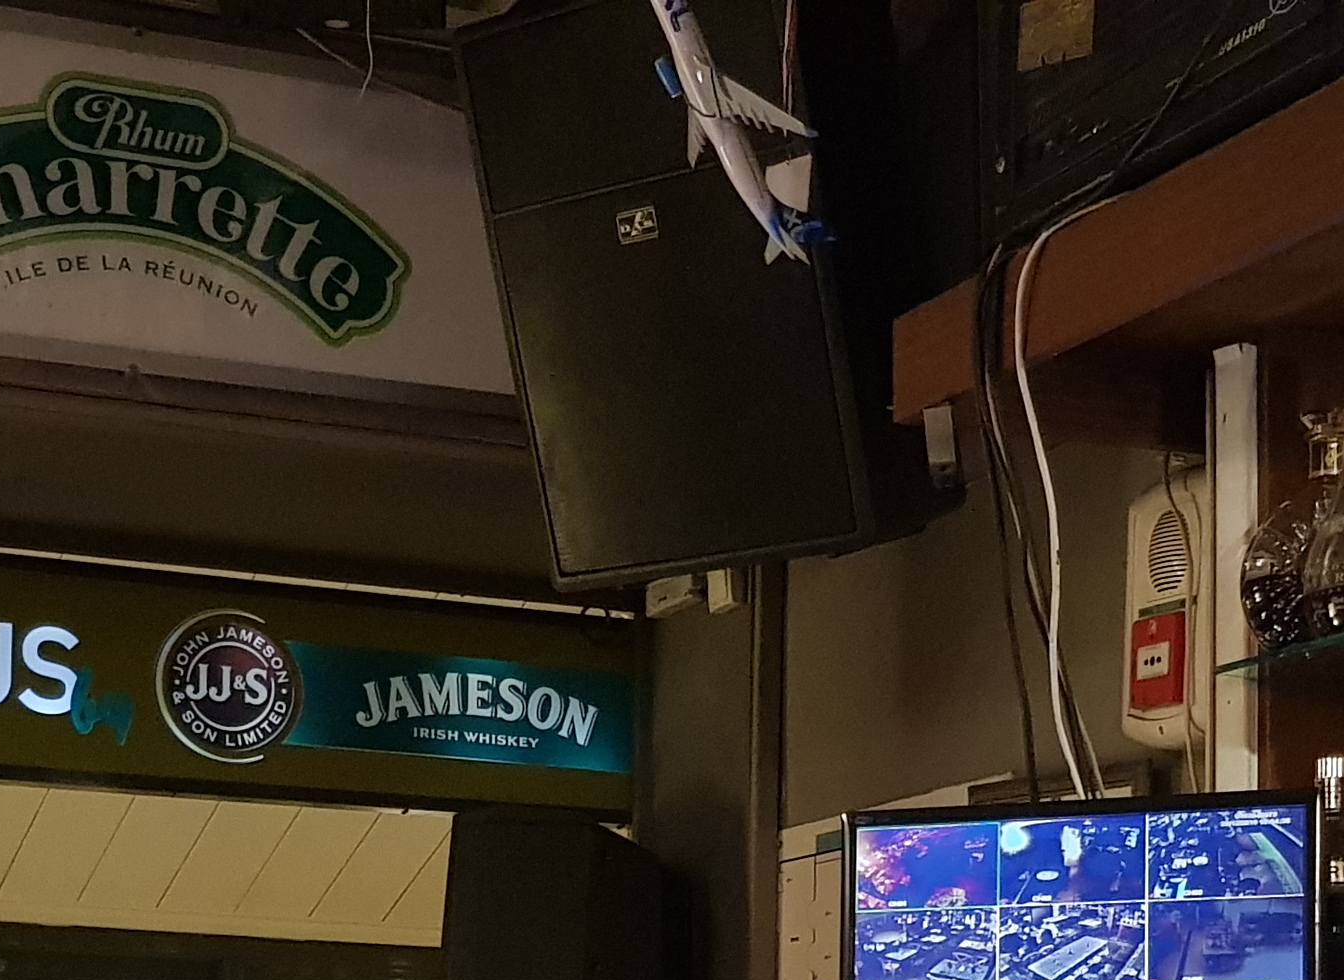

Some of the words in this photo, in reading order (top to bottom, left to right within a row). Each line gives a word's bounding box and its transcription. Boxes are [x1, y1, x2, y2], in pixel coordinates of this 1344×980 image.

[73, 93, 207, 156] Rhum
[4, 261, 47, 286] ILE
[57, 254, 91, 274] DE
[102, 253, 132, 273] LA
[144, 260, 260, 318] RÉUNION
[172, 630, 210, 677] JOHN
[215, 625, 290, 684] JAMESON
[185, 663, 270, 706] JJ&S
[355, 671, 601, 748] JAMESON
[181, 710, 218, 743] SON
[225, 700, 288, 747] LIMITED
[412, 726, 459, 742] IRISH
[463, 730, 540, 749] WHISKEY
